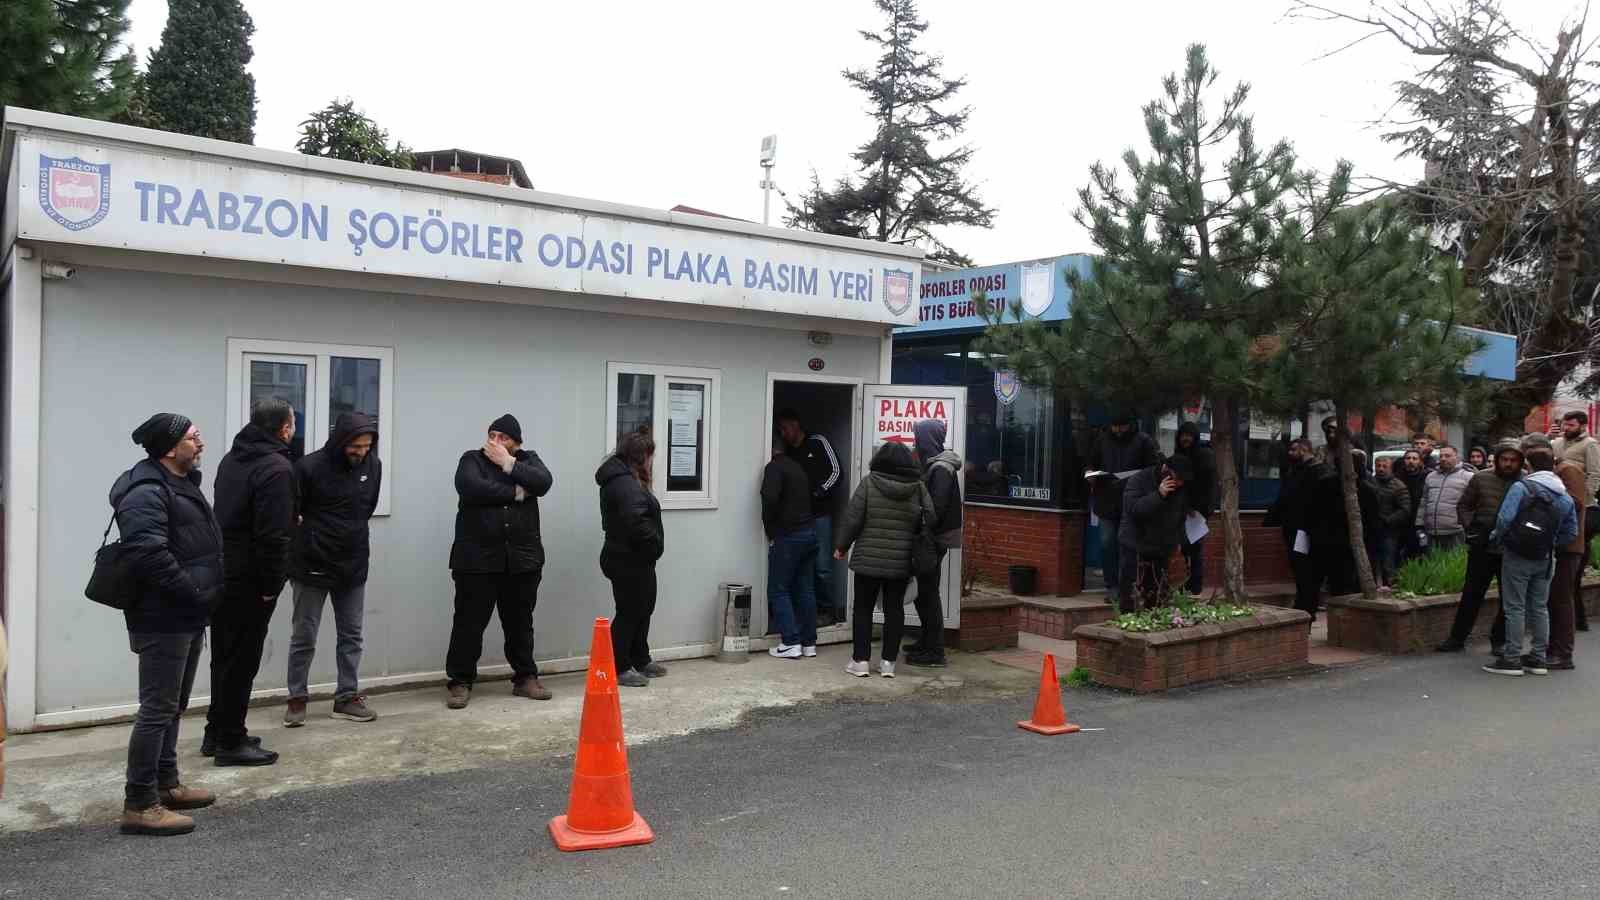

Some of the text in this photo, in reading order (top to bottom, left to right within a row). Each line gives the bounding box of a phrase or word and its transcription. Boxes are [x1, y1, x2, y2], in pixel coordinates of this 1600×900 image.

[134, 181, 328, 241] TRABZON
[348, 209, 523, 263] ŞOFÖRLER
[538, 233, 632, 275] ODASI
[648, 246, 731, 286] PLAKA
[744, 259, 818, 295] BASIM
[828, 268, 872, 302] YERİ
[920, 279, 966, 299] OFORLER
[949, 297, 1006, 319] BÜRSU
[880, 399, 946, 418] PLAKA
